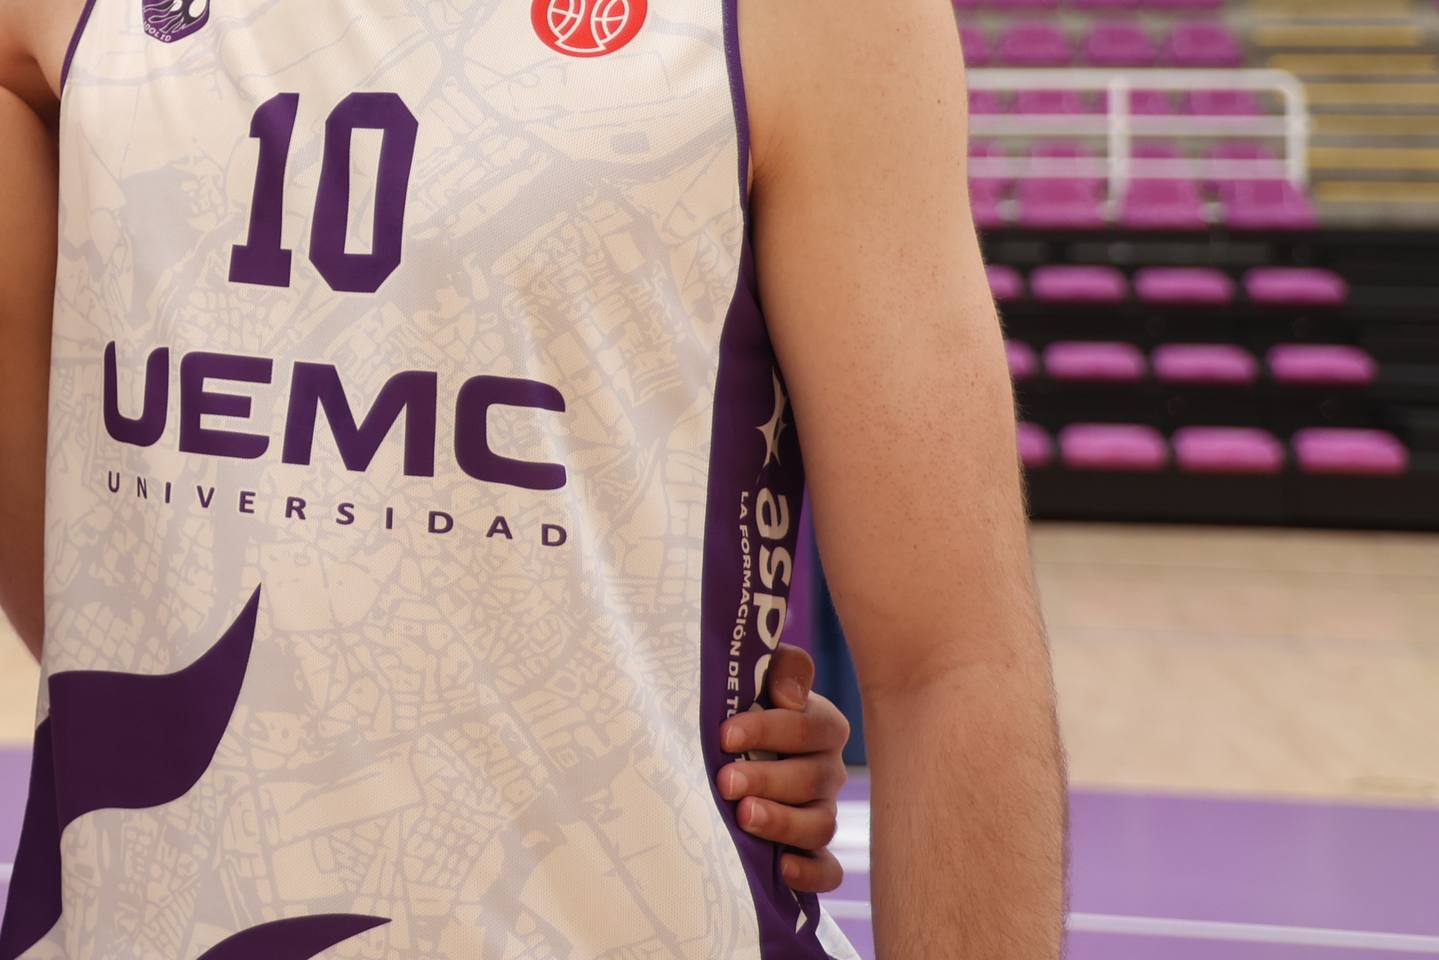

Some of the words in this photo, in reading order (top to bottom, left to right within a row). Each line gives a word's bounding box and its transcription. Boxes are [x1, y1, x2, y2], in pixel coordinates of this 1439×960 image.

[228, 91, 419, 293] 10
[102, 339, 568, 491] UEMC
[107, 470, 569, 548] UNIVERSIDAD
[739, 490, 749, 520] LA
[730, 524, 752, 656] FORMACIÓN
[727, 661, 739, 692] DE
